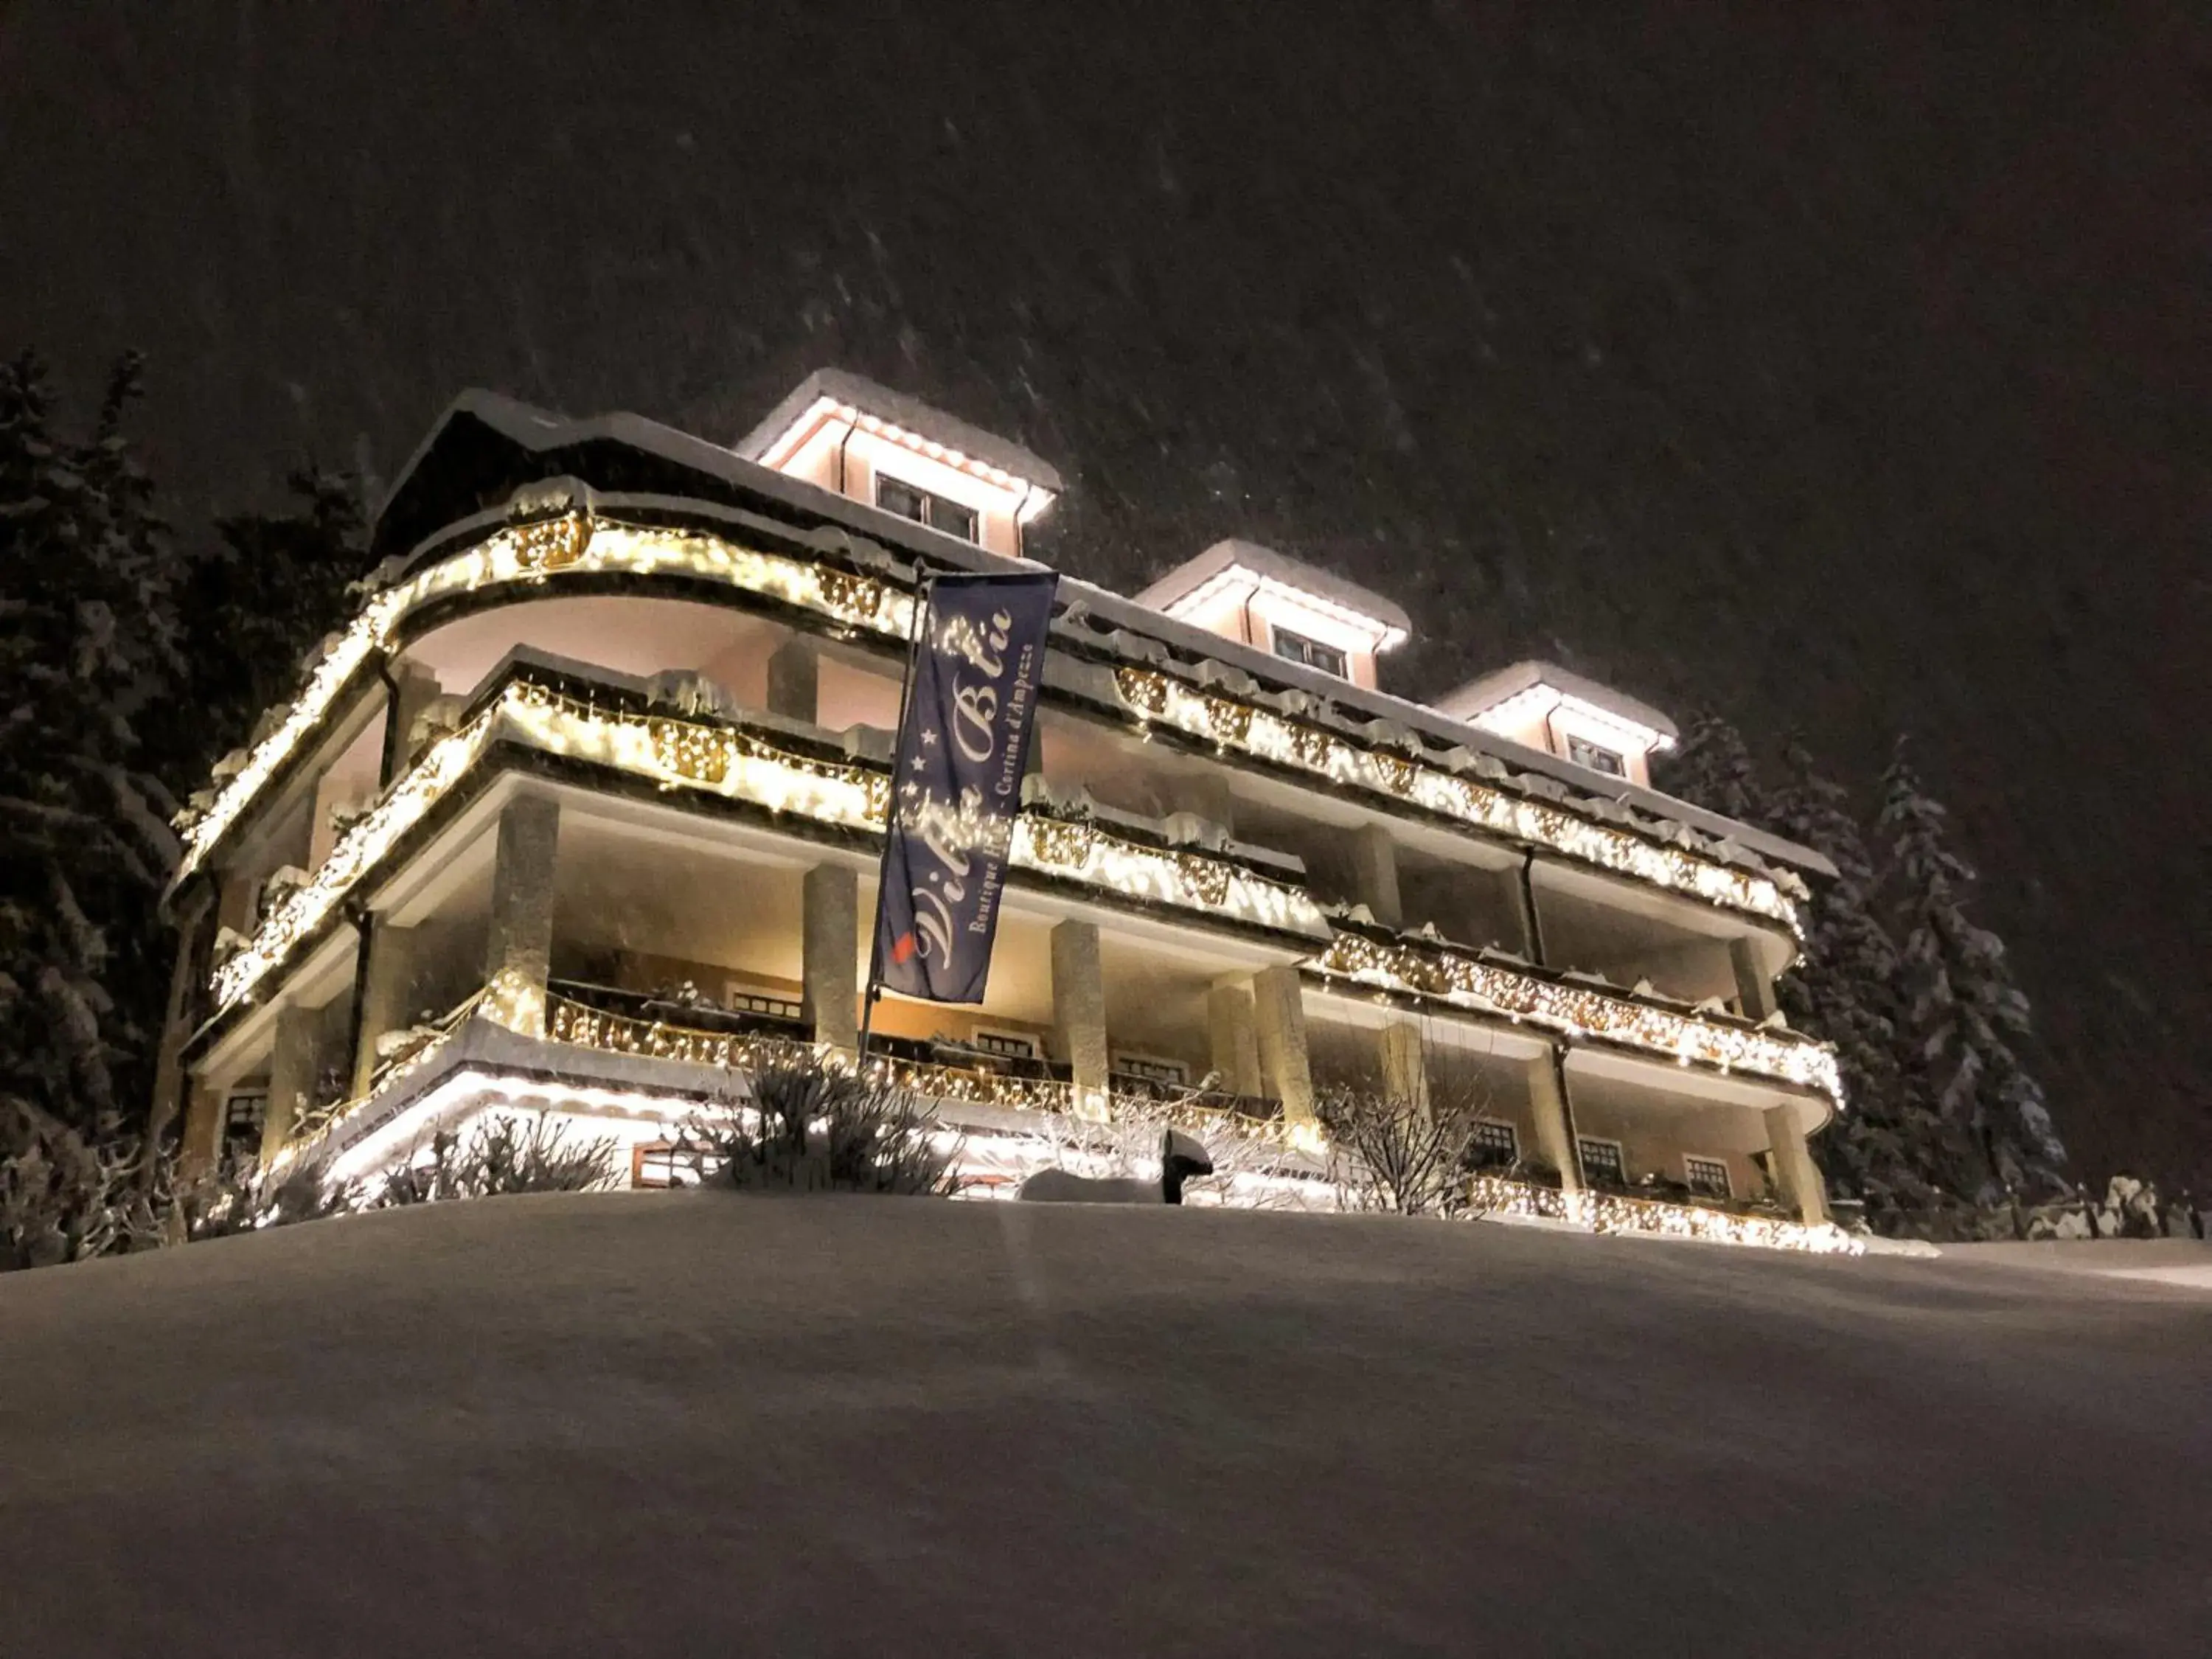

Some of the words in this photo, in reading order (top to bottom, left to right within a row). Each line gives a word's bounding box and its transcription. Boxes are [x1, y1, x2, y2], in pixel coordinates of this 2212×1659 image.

[953, 608, 1012, 762] Blu
[1004, 643, 1034, 728] d'Ampezzo
[995, 735, 1020, 796] Cortina
[983, 815, 1008, 858] Hol
[969, 862, 1001, 934] Boutique
